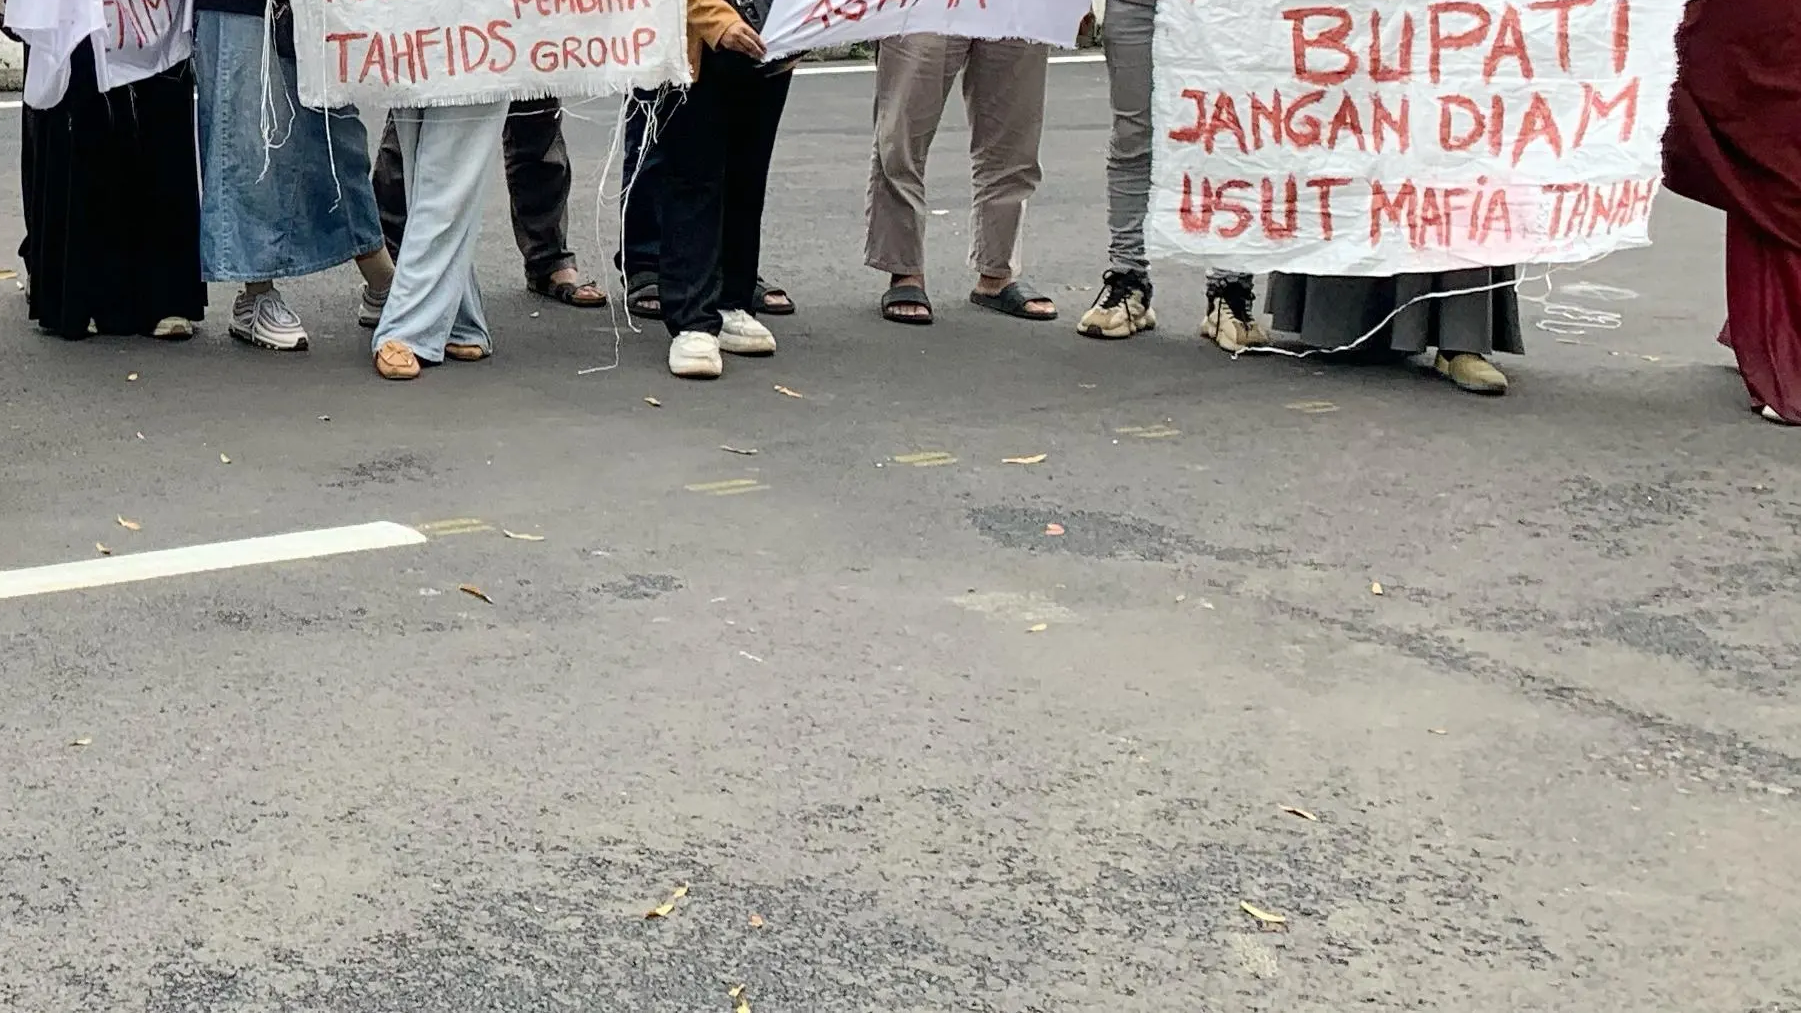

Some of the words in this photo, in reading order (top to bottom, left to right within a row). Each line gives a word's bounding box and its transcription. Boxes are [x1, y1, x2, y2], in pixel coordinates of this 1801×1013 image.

[325, 19, 518, 87] TAHFIDS
[530, 27, 657, 74] GROUP
[1168, 88, 1411, 155] JANGAN
[1436, 75, 1641, 168] DIAM
[1178, 172, 1353, 241] USUT
[1540, 176, 1658, 241] TANAH
